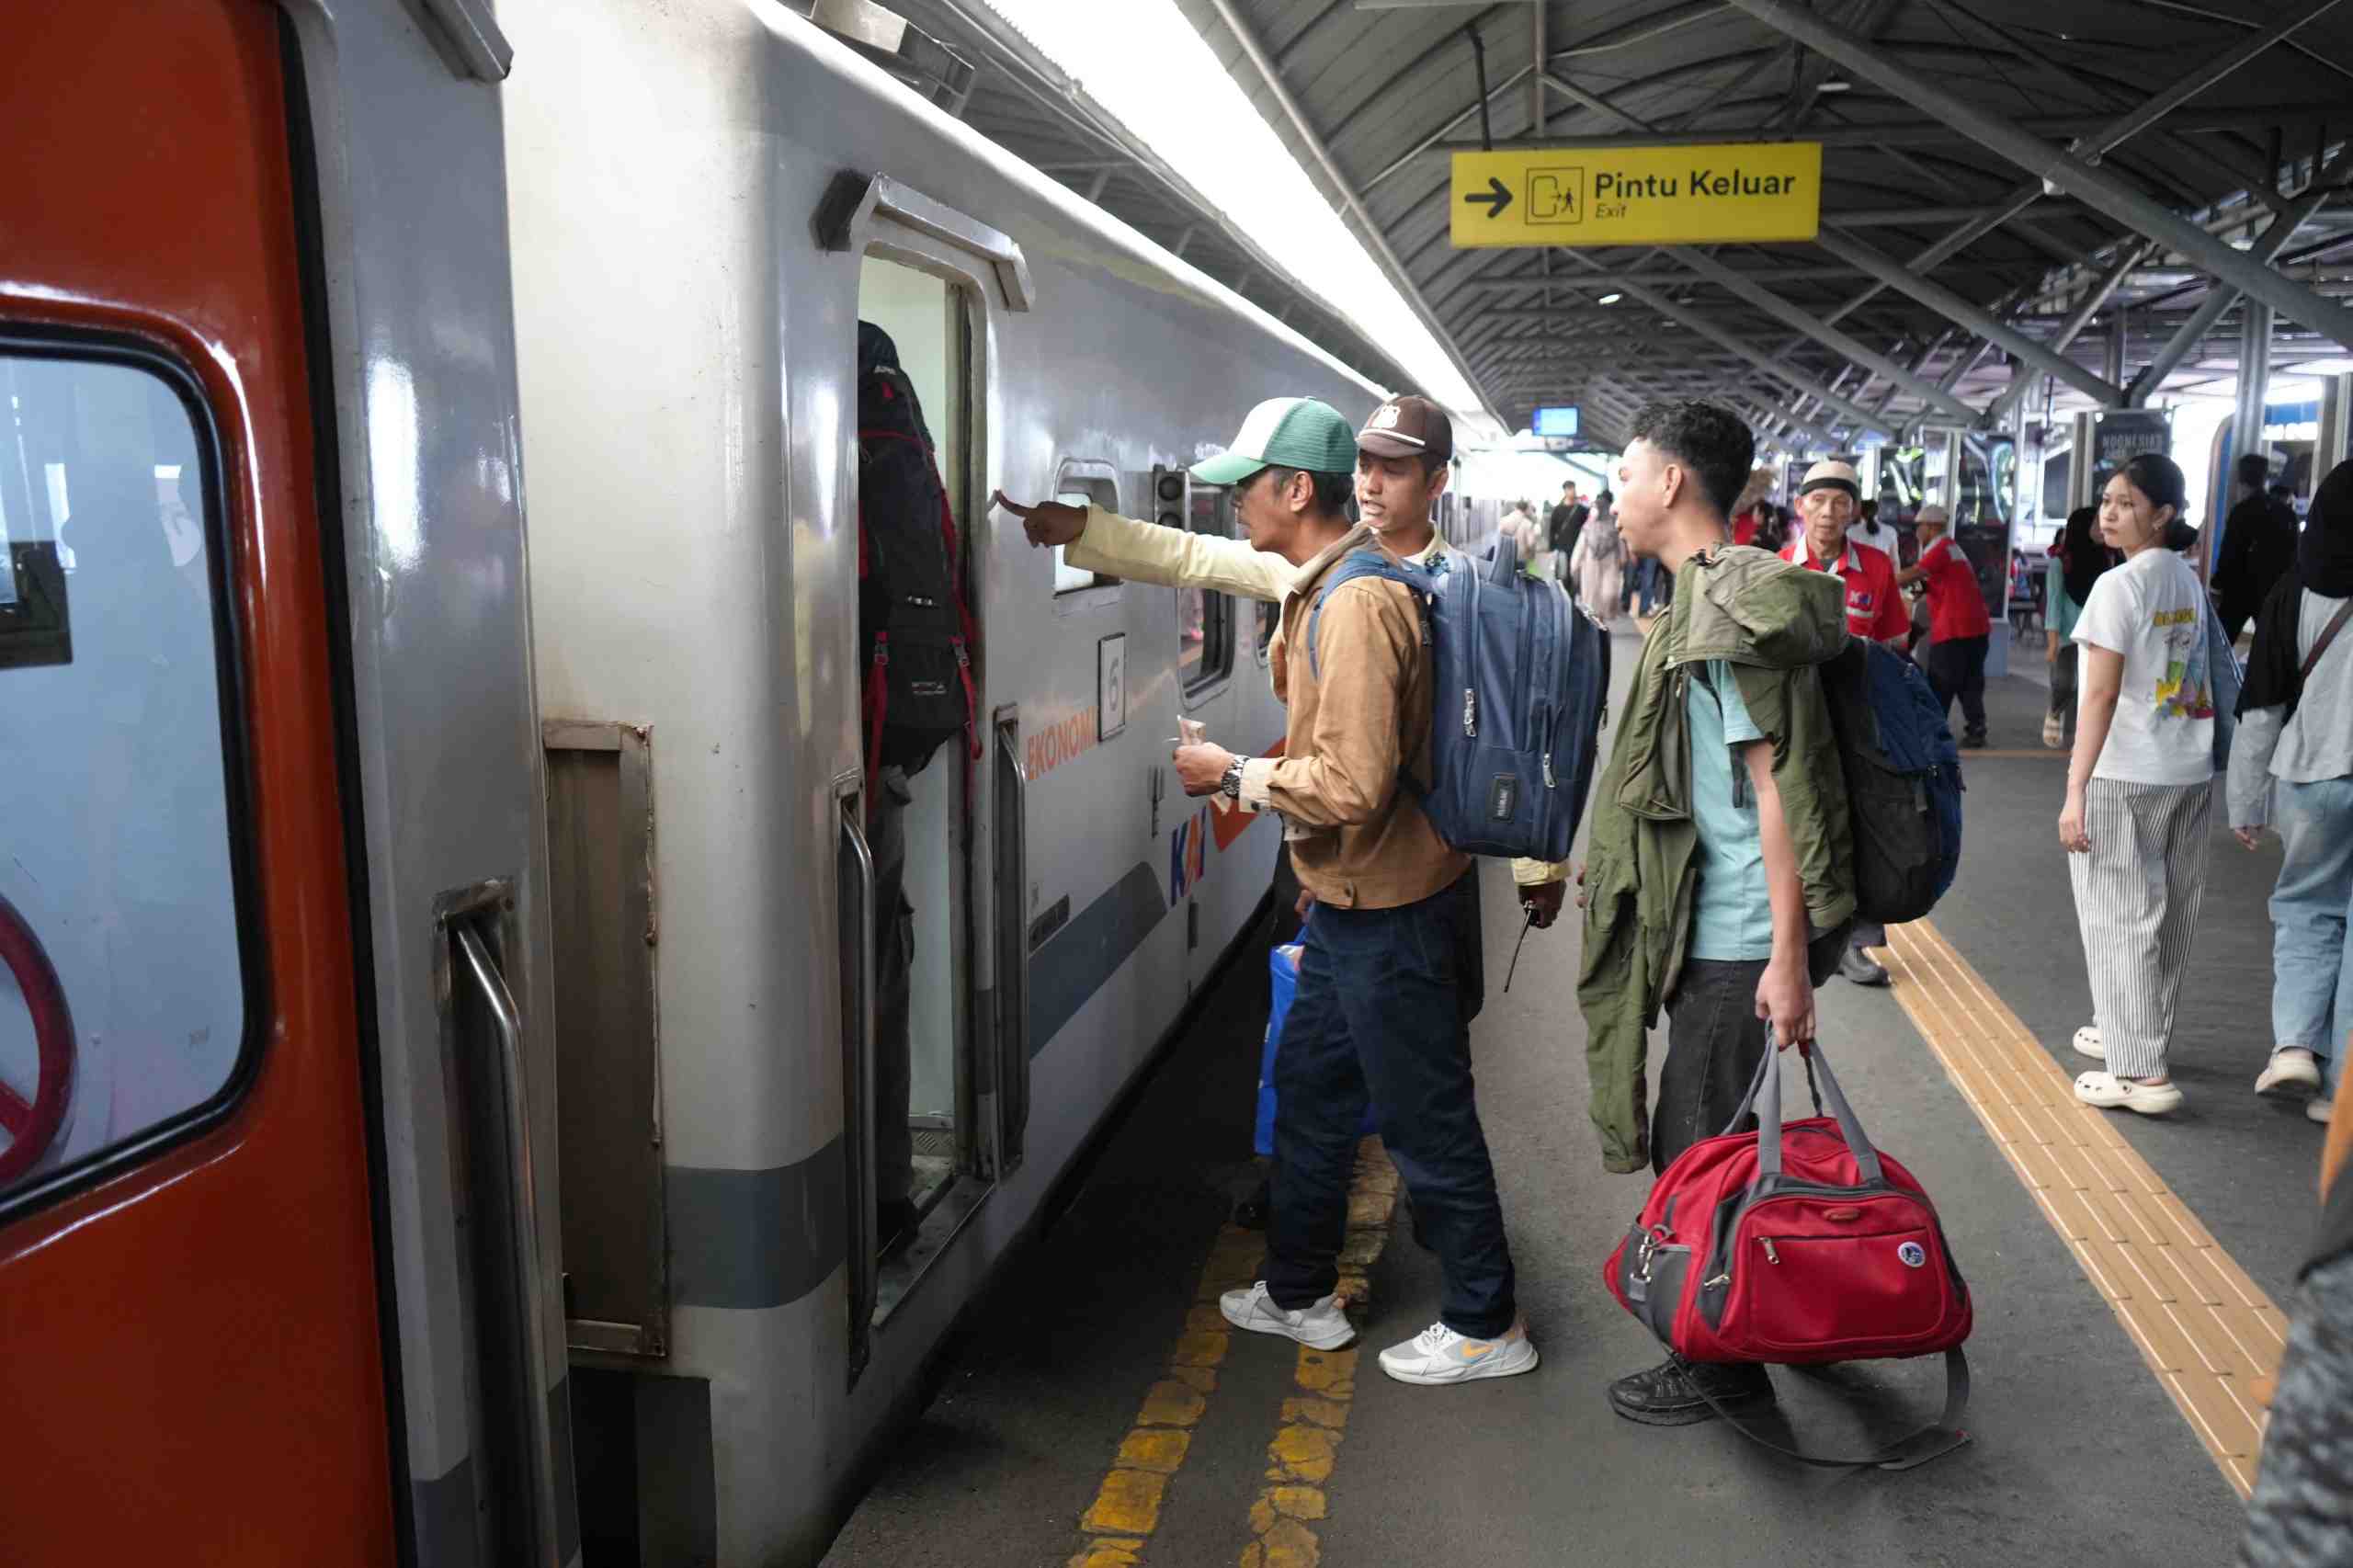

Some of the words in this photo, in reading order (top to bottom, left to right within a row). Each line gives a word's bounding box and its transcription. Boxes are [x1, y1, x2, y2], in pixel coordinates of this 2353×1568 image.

[1596, 172, 1677, 199] Pintu
[1689, 168, 1796, 197] Keluar
[1595, 202, 1627, 220] Exit
[1028, 706, 1098, 780] EKONOMI
